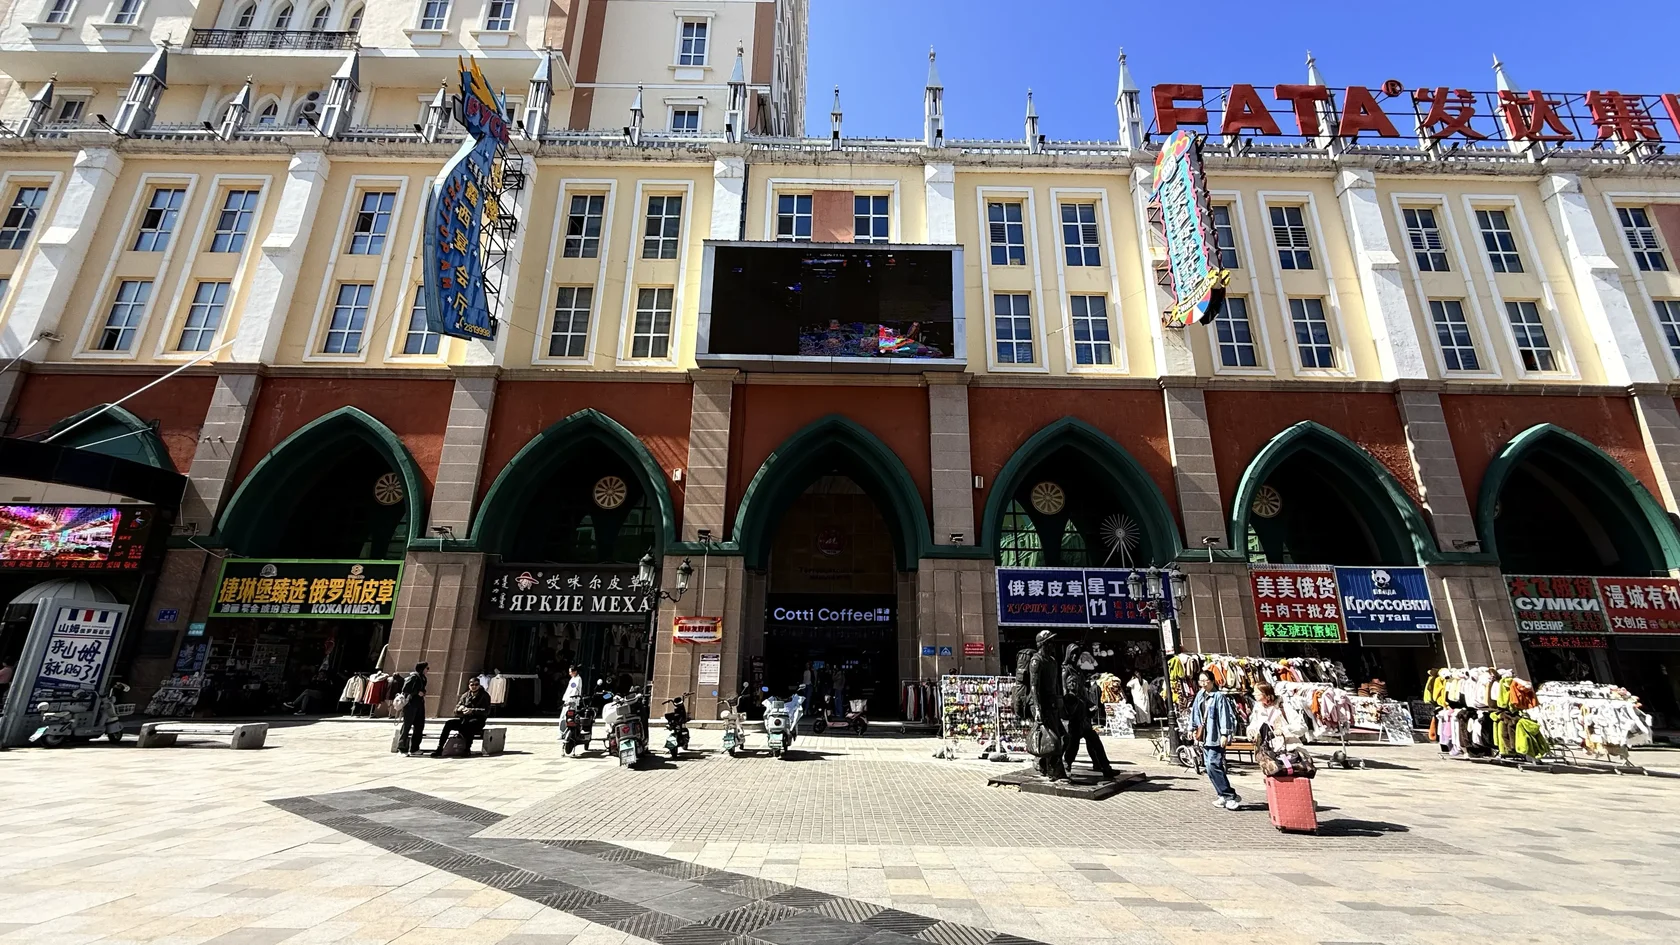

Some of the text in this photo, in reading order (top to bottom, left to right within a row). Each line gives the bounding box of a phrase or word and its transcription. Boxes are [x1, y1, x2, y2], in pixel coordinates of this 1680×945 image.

[1153, 83, 1400, 138] FATA
[1414, 87, 1680, 142] 发达集
[217, 577, 396, 605] 捷琳堡臻选 俄罗斯皮草
[1008, 579, 1084, 598] 俄蒙皮草
[1256, 575, 1337, 599] 美美俄货
[509, 594, 651, 613] ЯРКИЕ МЕХА
[1260, 602, 1339, 619] 牛肉干批发
[1344, 596, 1431, 614] Кроссовки
[1515, 597, 1600, 611] СУМКИ
[773, 607, 874, 622] Cotti Coffee
[1612, 616, 1648, 629] 文创店
[58, 623, 80, 634] 山姆
[1521, 620, 1564, 631] СУВЕНИР
[51, 639, 102, 664] 来山姆
